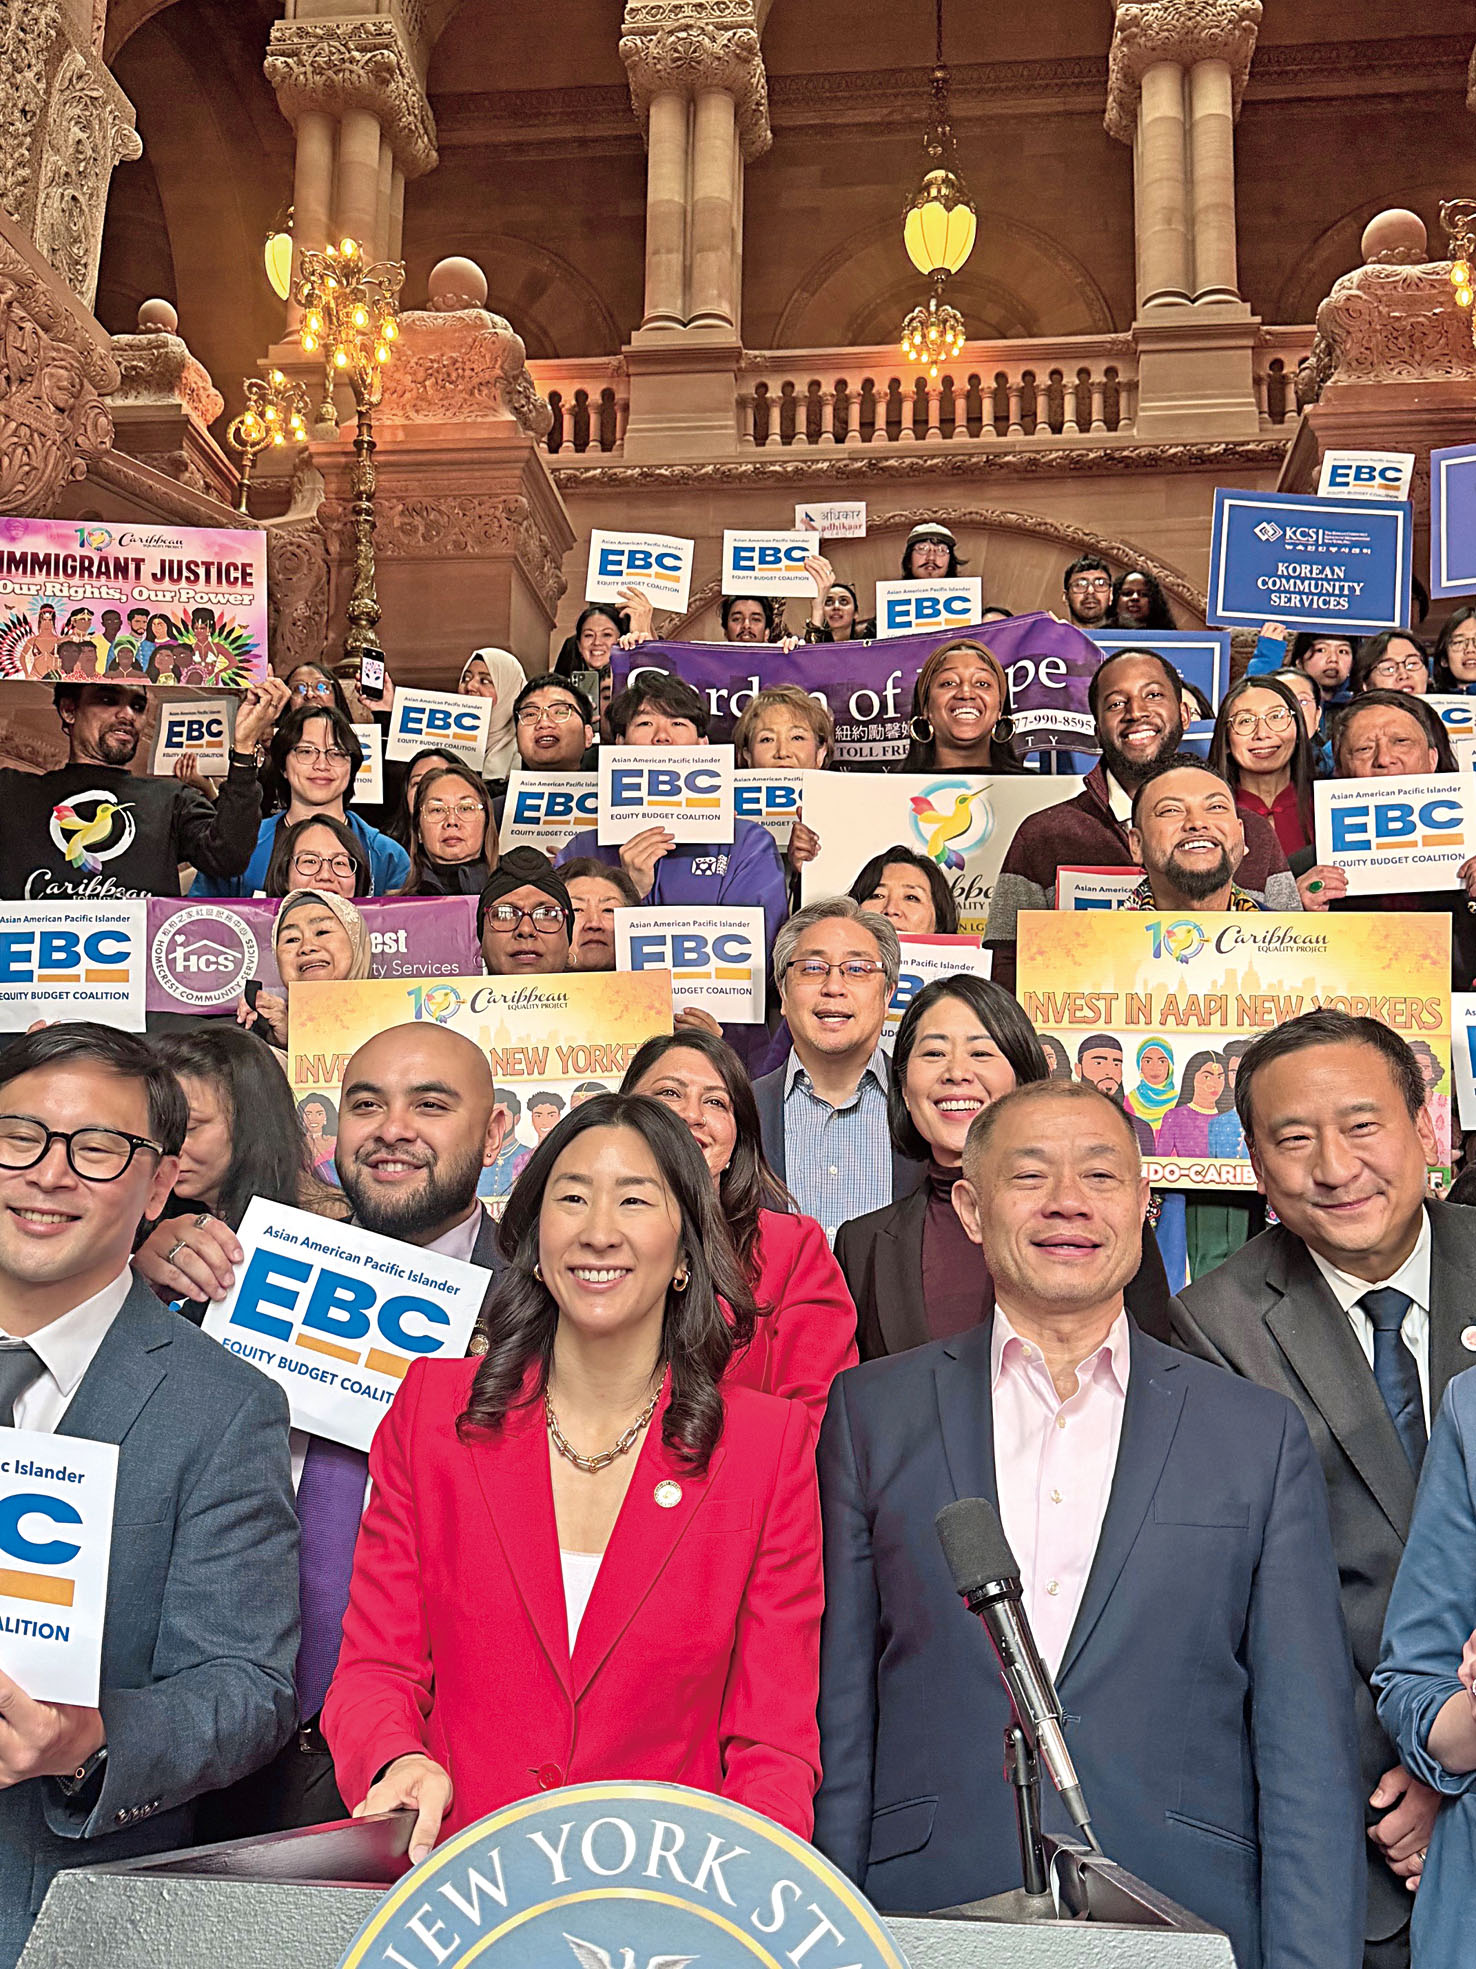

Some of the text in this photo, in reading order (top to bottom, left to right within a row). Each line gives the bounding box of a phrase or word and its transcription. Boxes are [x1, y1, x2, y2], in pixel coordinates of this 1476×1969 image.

[1328, 464, 1403, 487] EBC
[118, 532, 183, 547] Caribbean
[1285, 527, 1317, 541] KCS
[0, 550, 254, 587] IMMIGRANT JUSTICE
[598, 548, 683, 577] EBC
[732, 546, 810, 572] EBC
[1277, 562, 1345, 579] KOREAN
[0, 579, 254, 606] Our Rights, Our Power
[646, 582, 680, 593] COALITION
[1257, 577, 1364, 596] COMMUNITY
[887, 596, 971, 629] EBC
[1270, 593, 1349, 610] SERVICES
[850, 669, 902, 721] of
[165, 718, 223, 748] EBC
[399, 705, 482, 735] EBC
[444, 743, 477, 752] COALITION
[612, 756, 632, 764] Asian
[838, 747, 878, 758] TOLL
[611, 769, 722, 807] EBC
[734, 786, 802, 816] EB
[1330, 785, 1461, 800] Asian American Pacific Islander
[513, 791, 598, 825] EBC
[641, 812, 675, 820] BUDGET
[676, 813, 721, 821] COALITION
[1331, 800, 1464, 852] EBC
[1333, 853, 1465, 867] EQUITY BUDGET COALITION
[25, 868, 152, 900] Caribbean
[1074, 884, 1097, 892] Asian
[23, 915, 62, 923] American
[64, 914, 93, 923] Pacific
[95, 915, 130, 923] Islander
[653, 920, 691, 928] American
[693, 919, 718, 928] Pacific
[719, 920, 750, 928] Islander
[629, 934, 752, 971] EBC
[1215, 925, 1330, 954] Caribbean
[1258, 945, 1328, 953] EQUALITY PROJECT
[0, 930, 131, 983] EBC
[391, 960, 460, 976] Services
[911, 959, 938, 969] Pacific
[940, 962, 975, 971] Islander
[155, 938, 256, 1002] HOMECREST COMMUNITY SERVICES
[0, 991, 129, 1000] EQUITY BUDGET COALITION
[470, 986, 569, 1013] Caribbean
[706, 987, 752, 995] COALITION
[507, 1003, 539, 1011] EQUALITY
[1024, 991, 1118, 1025] INVEST
[1125, 993, 1152, 1025] IN
[1160, 993, 1228, 1026] AAPI
[1236, 994, 1303, 1027] NEW
[295, 1043, 640, 1083] INVE NEW YORKE
[263, 1225, 461, 1296] Asian American Pacific Islander
[229, 1247, 451, 1354] EBC
[222, 1338, 395, 1404] EQUITY BUDGET COALIT
[14, 1460, 86, 1484] Islander
[0, 1616, 70, 1642] LITION
[526, 1817, 751, 1907] YORK
